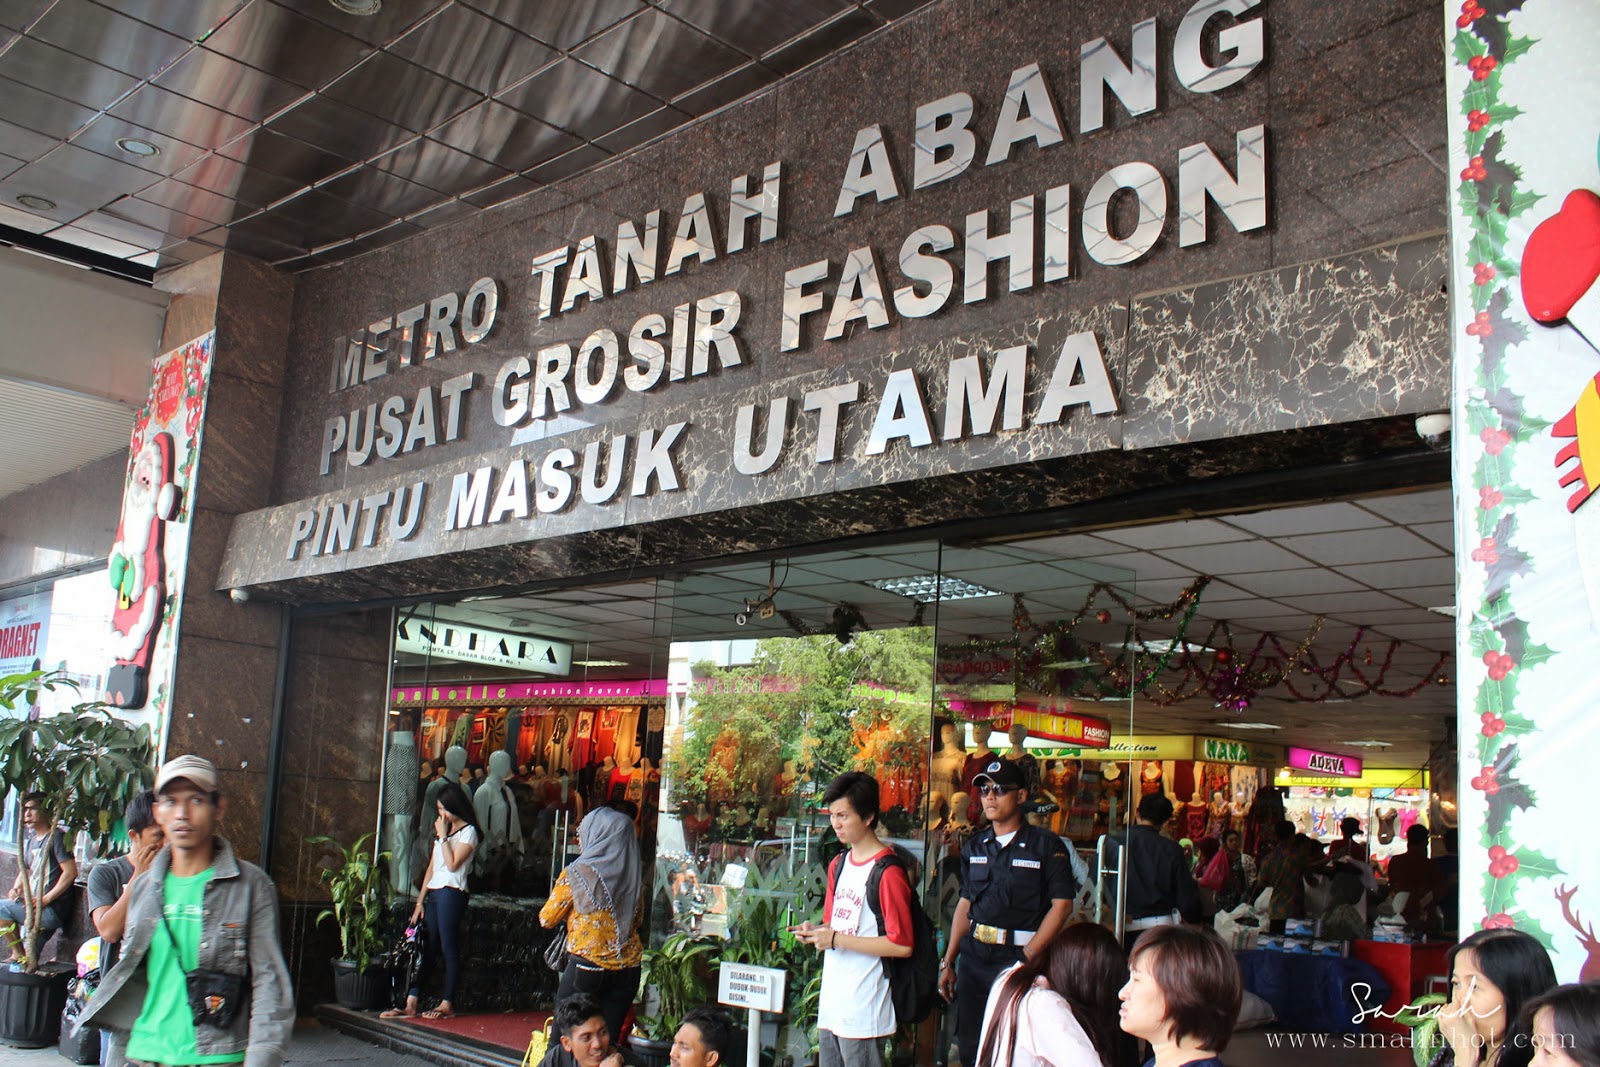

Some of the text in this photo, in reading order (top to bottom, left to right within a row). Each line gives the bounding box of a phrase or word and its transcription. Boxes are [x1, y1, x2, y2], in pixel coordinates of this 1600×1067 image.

[329, 0, 1265, 394] METRO TANAH ABANG
[319, 124, 1267, 476] PUSAT GROSIR FASHION
[286, 331, 1119, 561] PINTU MASUK UTAMA
[526, 687, 581, 696] Fashion
[1083, 726, 1109, 739] FASHION
[1308, 753, 1345, 774] ADEVA
